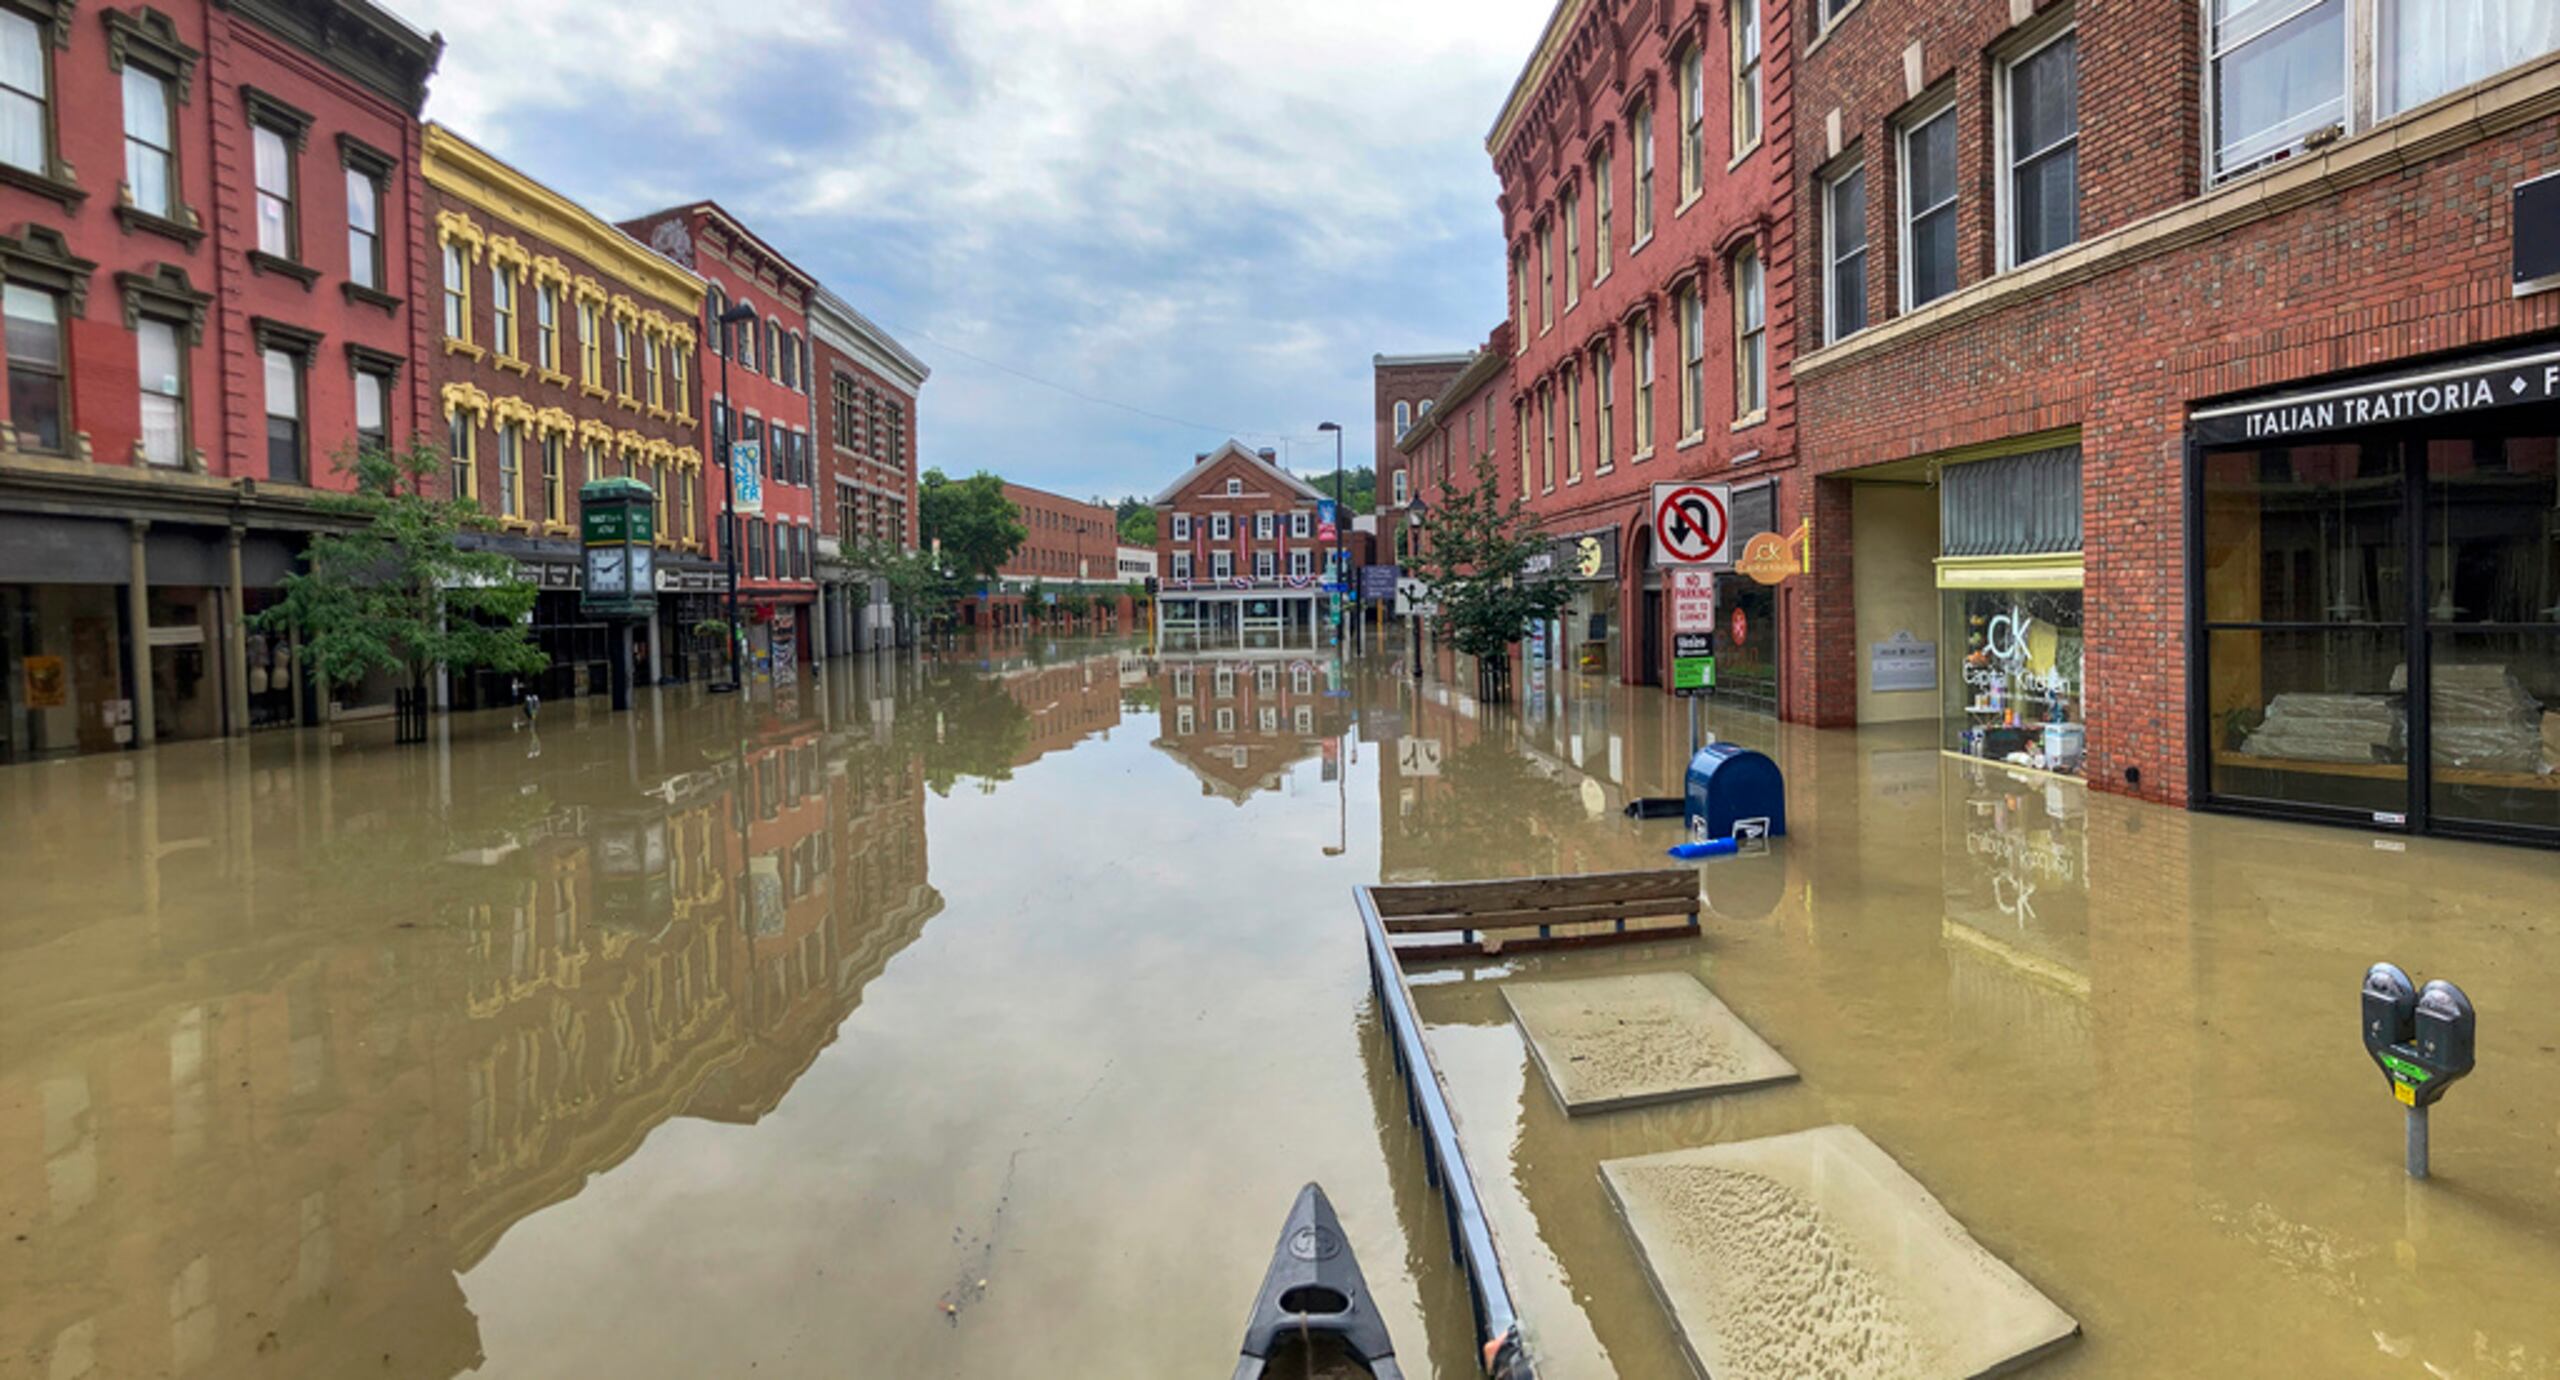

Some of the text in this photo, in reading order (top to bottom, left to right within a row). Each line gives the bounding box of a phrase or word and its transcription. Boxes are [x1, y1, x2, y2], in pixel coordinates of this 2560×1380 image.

[2246, 403, 2334, 437] ITALIAN
[2344, 379, 2494, 423] TRATTORIA
[1685, 575, 1700, 587] NO
[1675, 588, 1711, 599] PARKING
